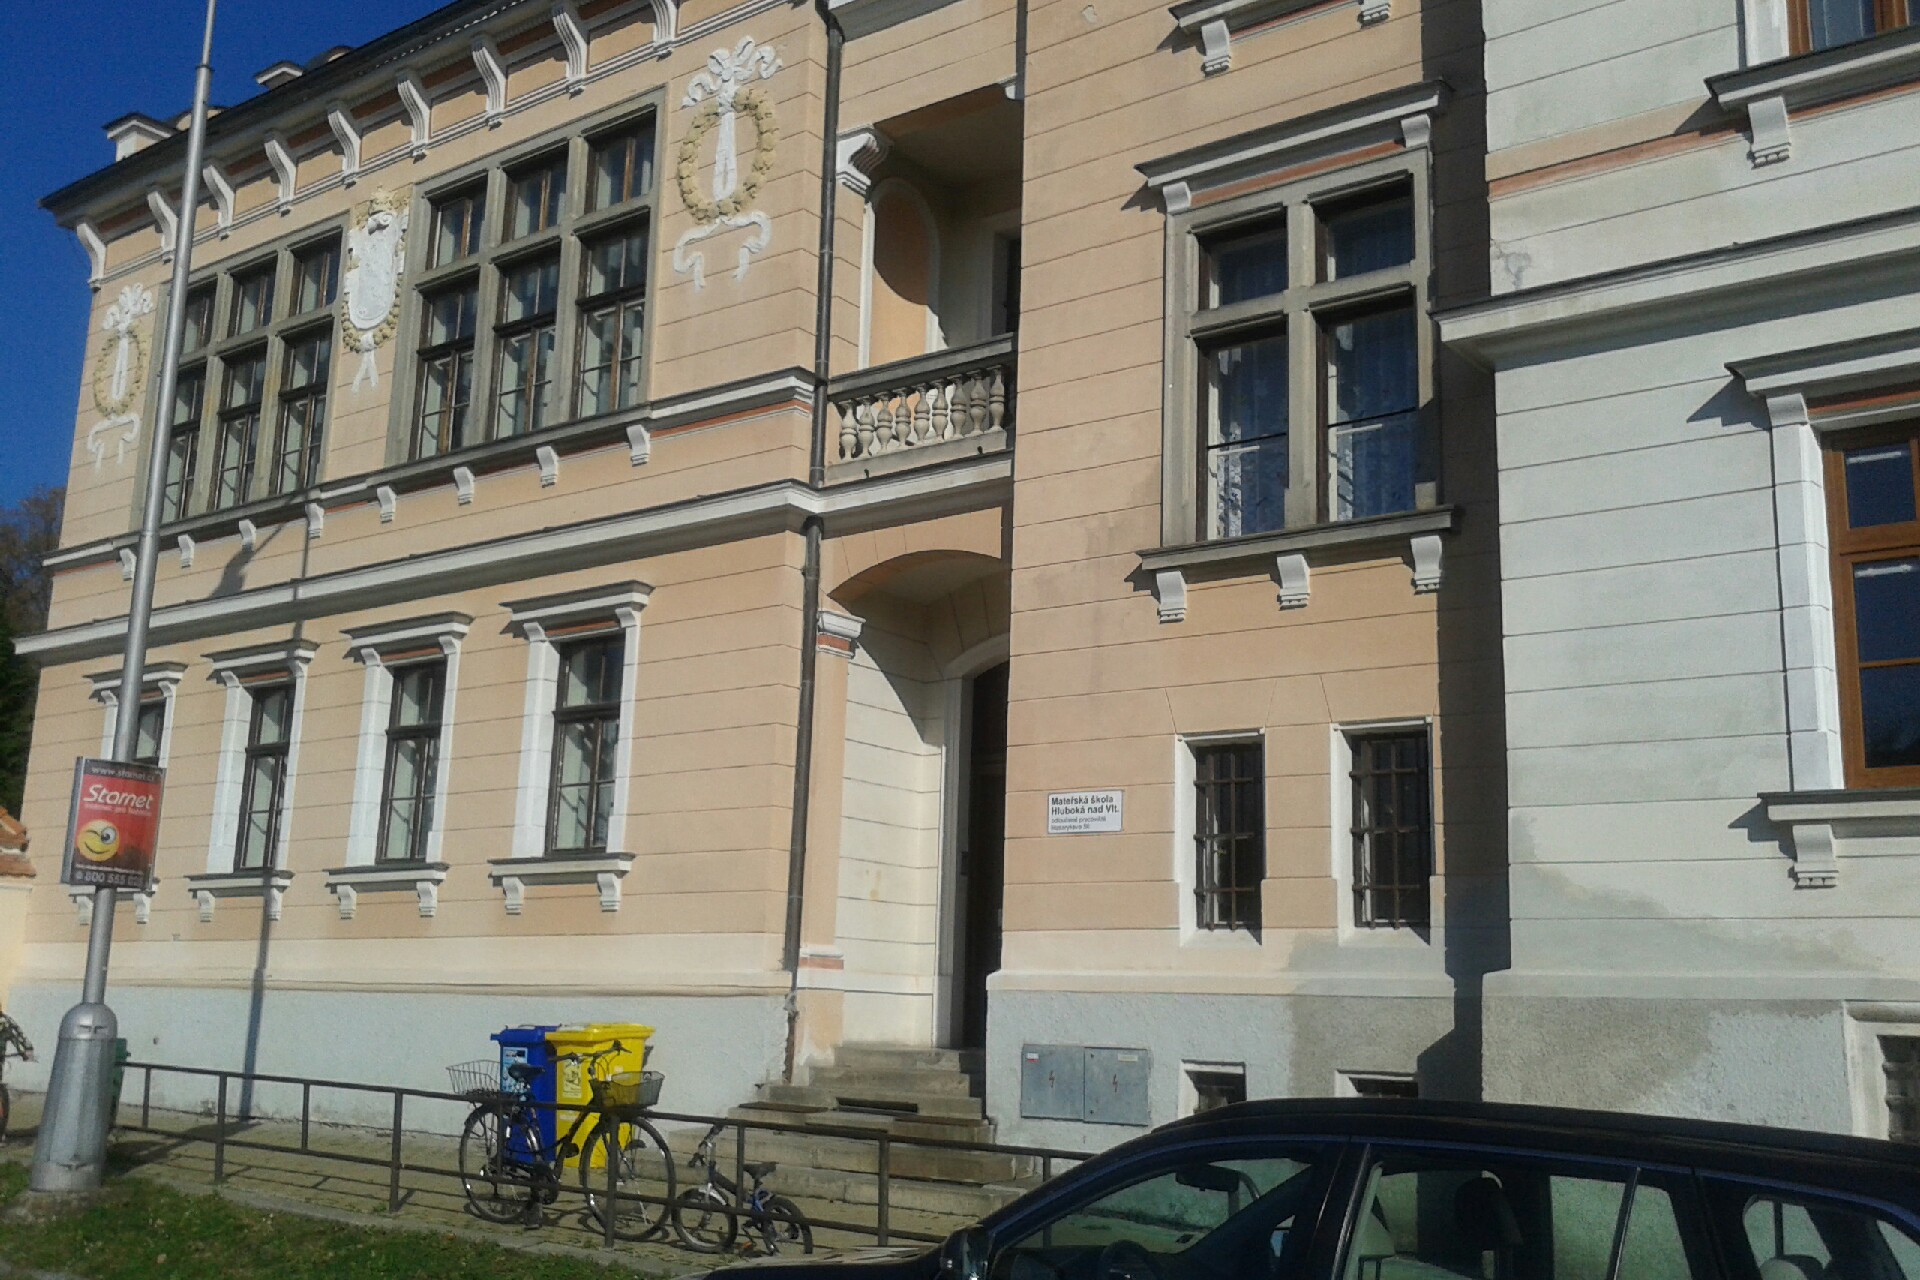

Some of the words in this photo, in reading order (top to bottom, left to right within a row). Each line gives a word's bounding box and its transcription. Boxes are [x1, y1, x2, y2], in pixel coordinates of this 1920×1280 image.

[1052, 796, 1088, 805] Mateřská
[1090, 795, 1114, 804] škola
[1052, 806, 1086, 815] Hluboká
[1088, 804, 1104, 814] nad
[1106, 804, 1119, 814] Vlt.
